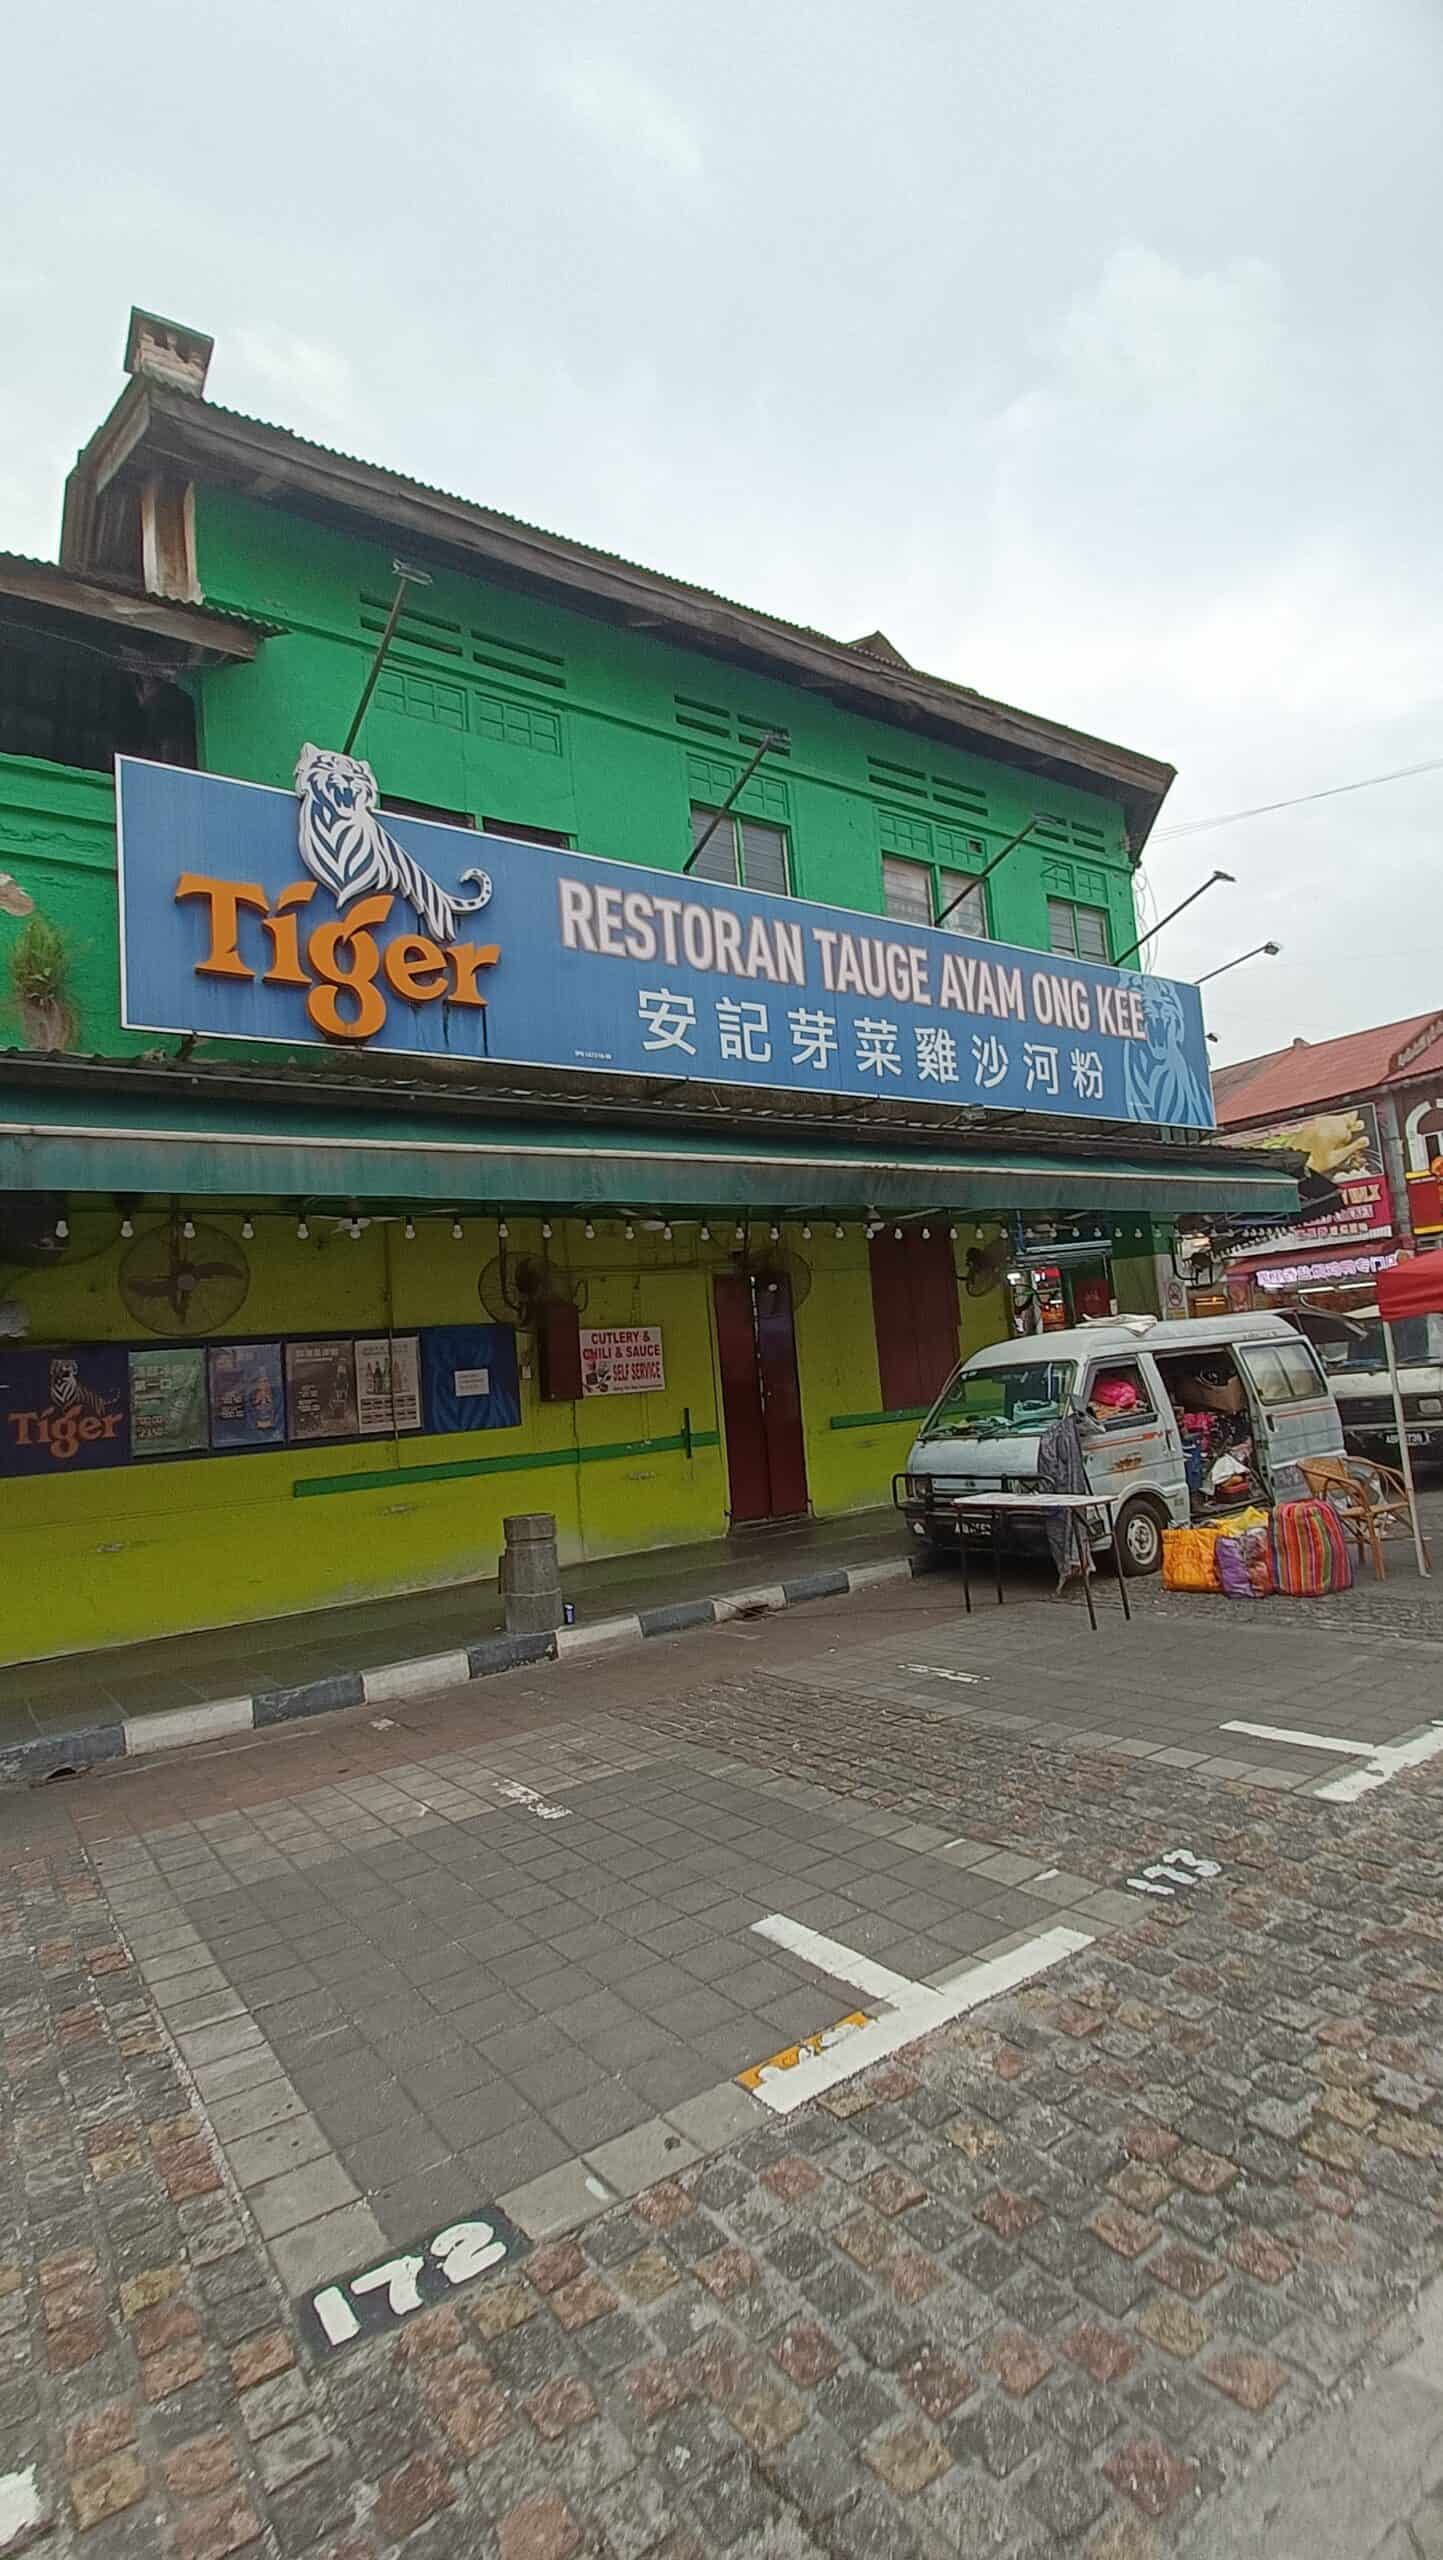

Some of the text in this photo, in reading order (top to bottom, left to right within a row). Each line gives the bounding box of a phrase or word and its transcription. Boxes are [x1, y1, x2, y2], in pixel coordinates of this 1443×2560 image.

[175, 872, 501, 1043] Tiger
[558, 877, 1148, 1041] RESTORAN TAUGE AYAM ONG KEE
[637, 988, 1104, 1100] 安記芽菜雞沙河粉
[582, 1344, 661, 1361] CHILI & SAUCE
[592, 1330, 651, 1345] CUTLERY &
[612, 1362, 661, 1381] SELF SERVICE
[8, 1404, 124, 1458] Tiger
[313, 2221, 507, 2347] 172
